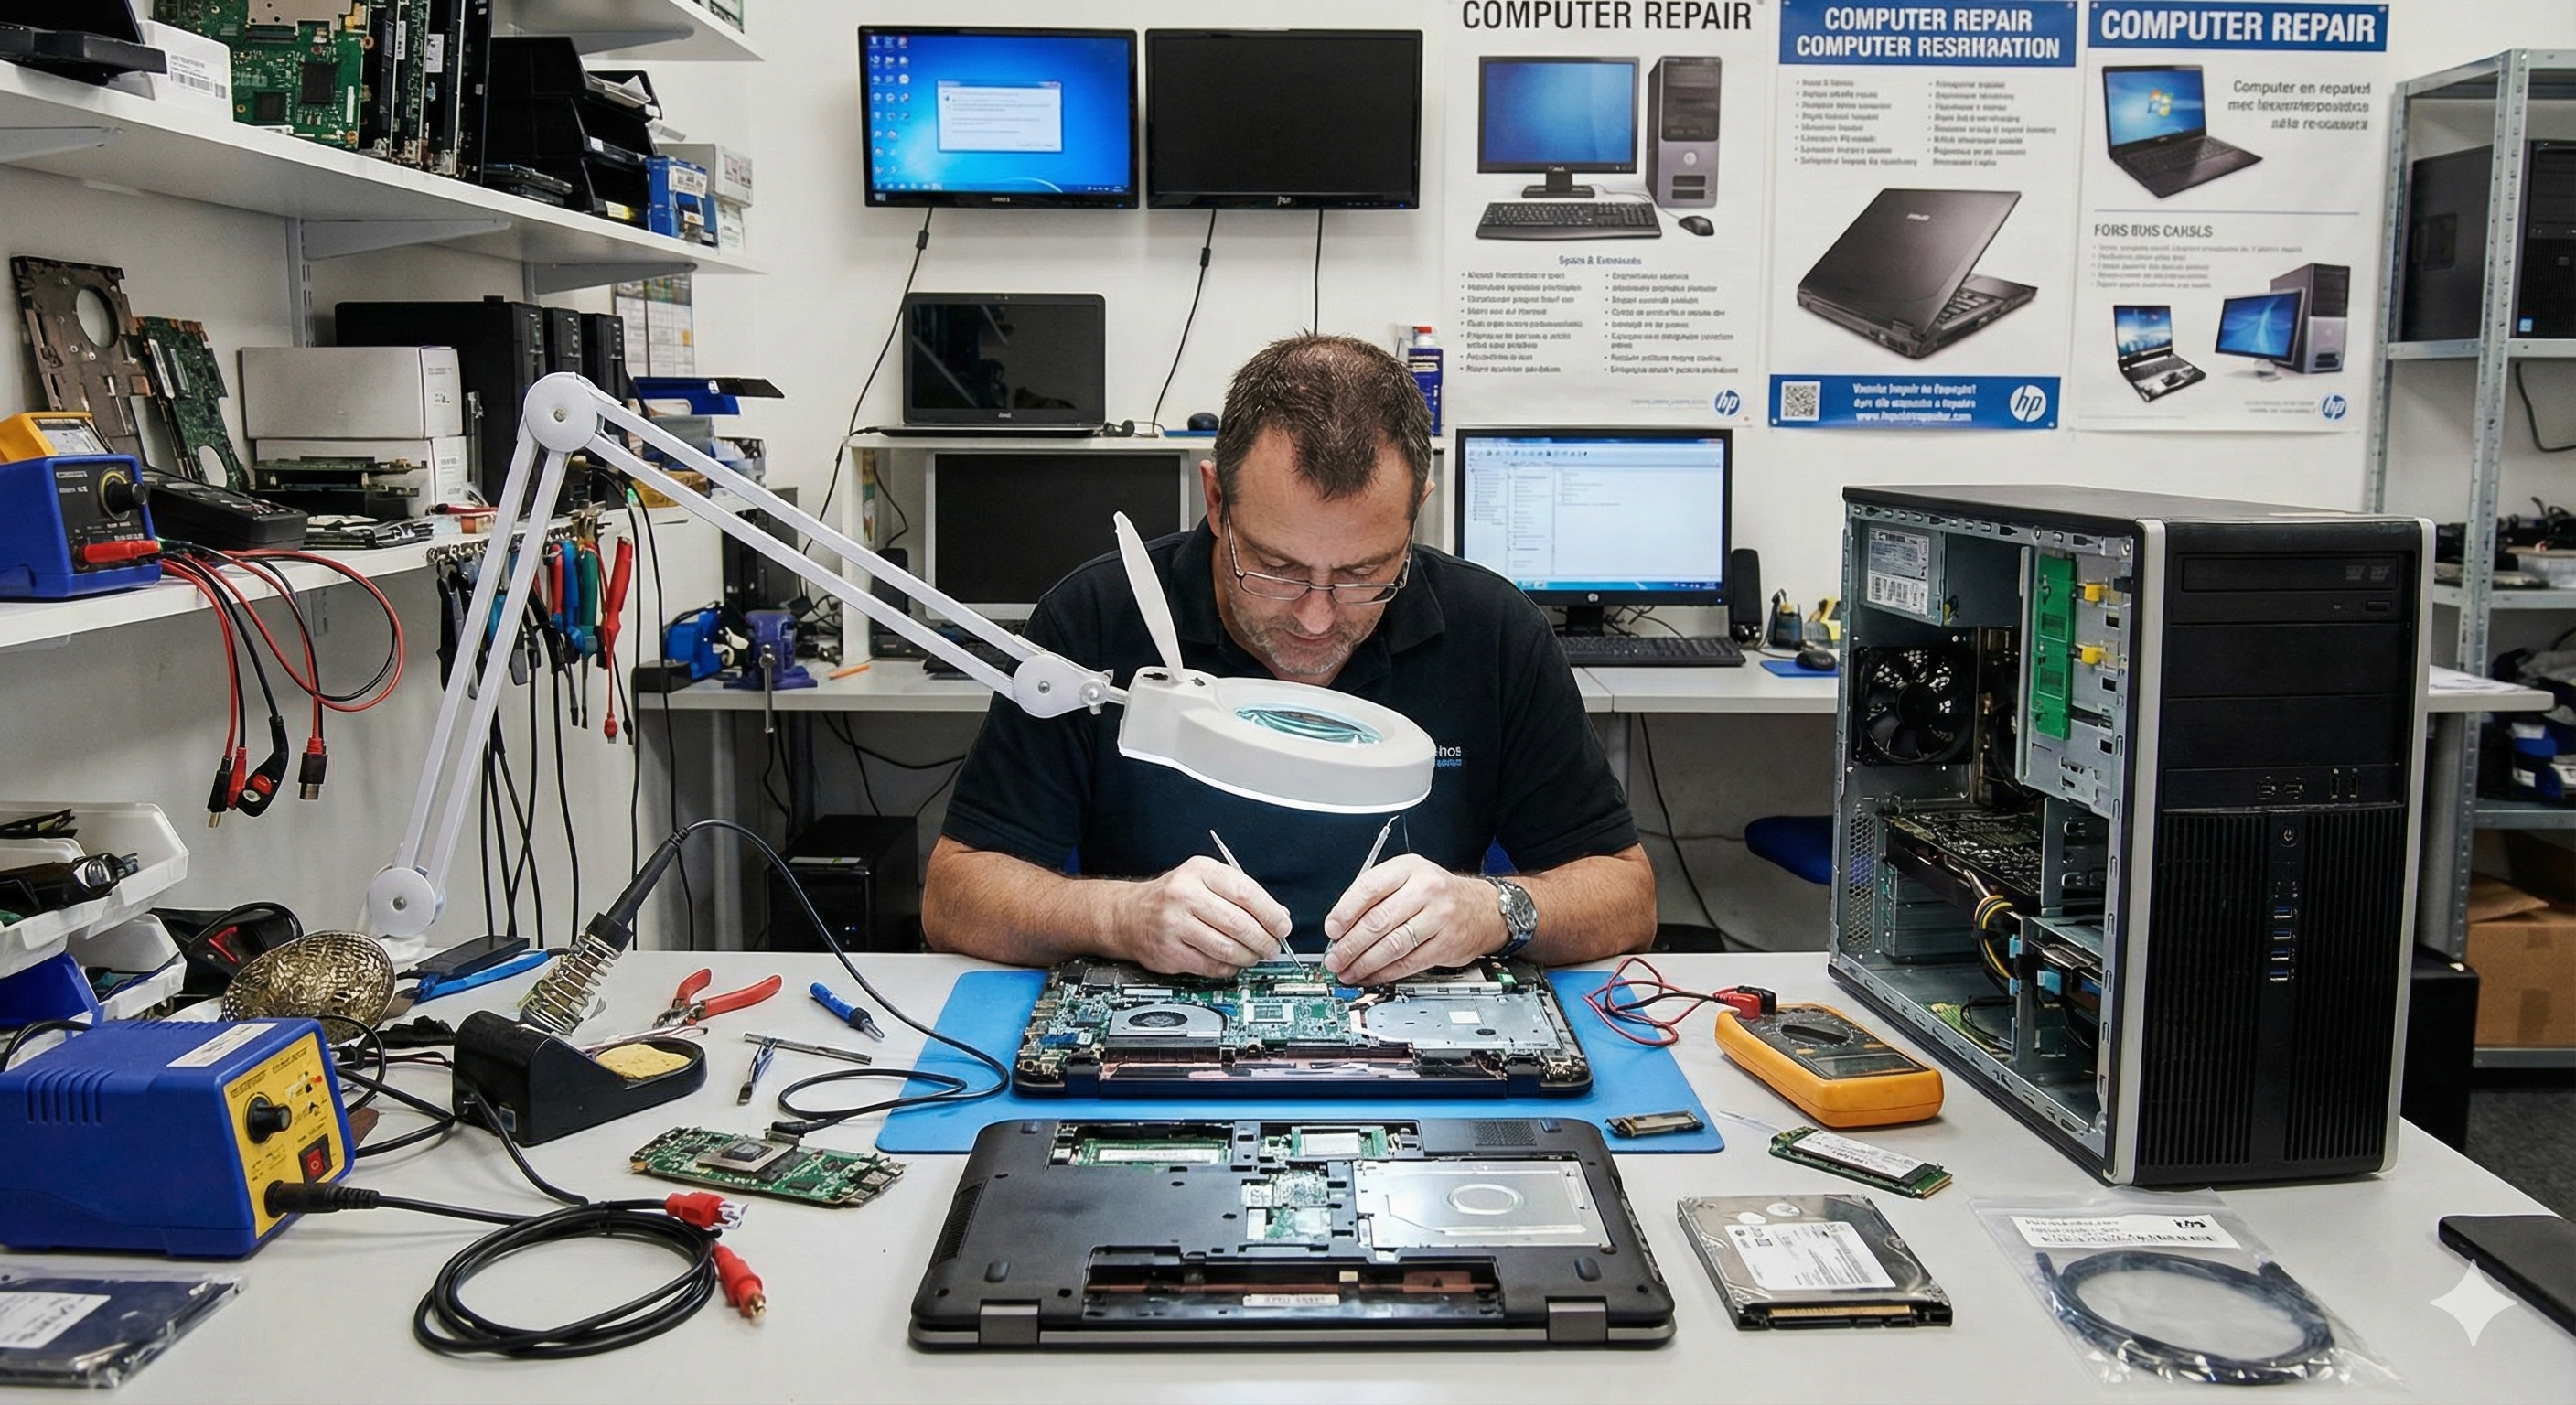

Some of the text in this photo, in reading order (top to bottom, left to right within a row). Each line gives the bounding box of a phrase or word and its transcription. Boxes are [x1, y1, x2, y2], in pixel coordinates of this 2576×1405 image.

[1463, 0, 1752, 30] COMPUTER REPAIR
[1825, 7, 2033, 32] COMPUTER REPAIR
[2101, 9, 2376, 42] COMPUTER REPAIR
[1796, 34, 1912, 57] COMPUTER
[2233, 80, 2296, 96] Computer
[2299, 83, 2316, 94] en
[2094, 223, 2129, 237] FORS
[1715, 389, 1740, 416] hp
[2012, 385, 2045, 422] hp
[2322, 394, 2346, 420] hp
